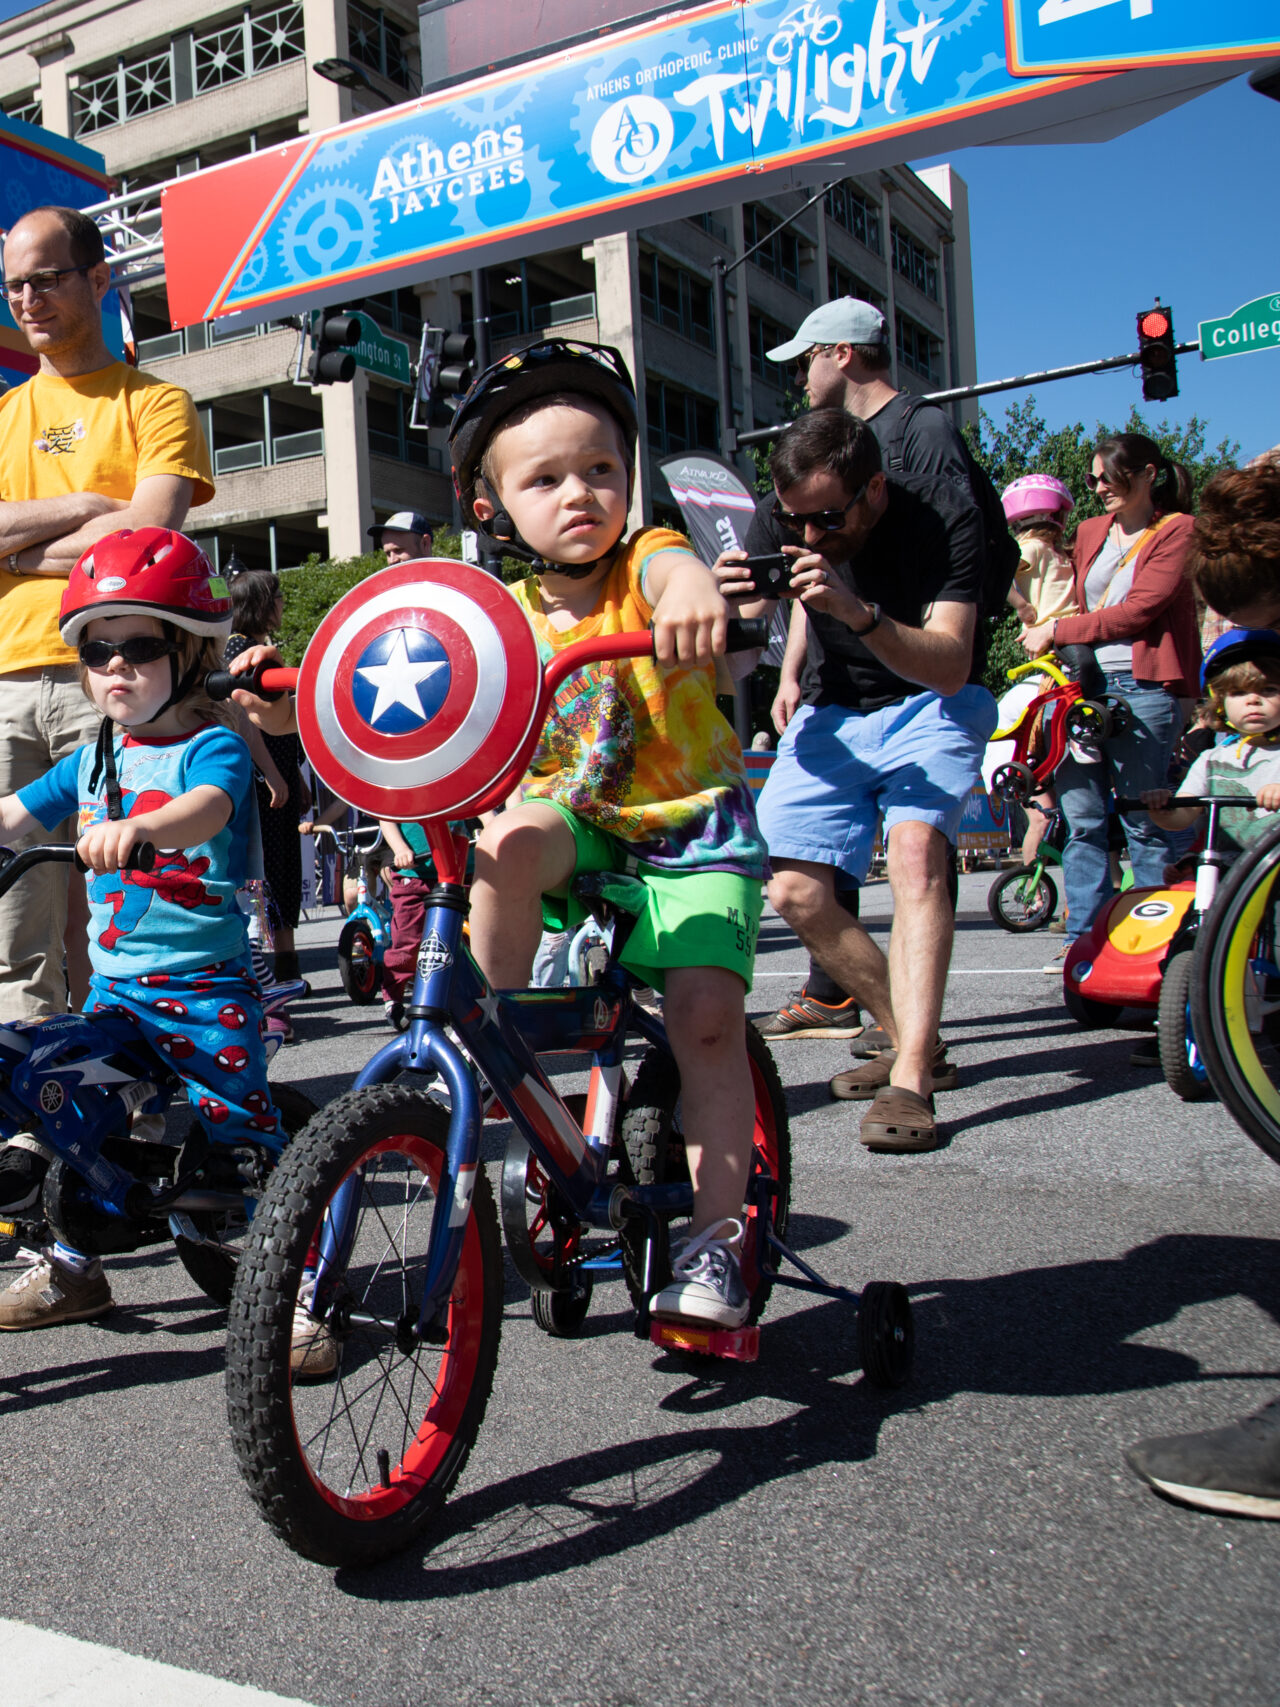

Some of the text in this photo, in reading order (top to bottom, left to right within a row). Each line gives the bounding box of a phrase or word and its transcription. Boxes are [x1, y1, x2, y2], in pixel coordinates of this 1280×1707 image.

[587, 37, 759, 102] ATHENS ORTHOPEDIC CLINIC
[673, 0, 944, 161] Twilight
[369, 125, 524, 201] Athens
[389, 160, 525, 224] JAYCEES
